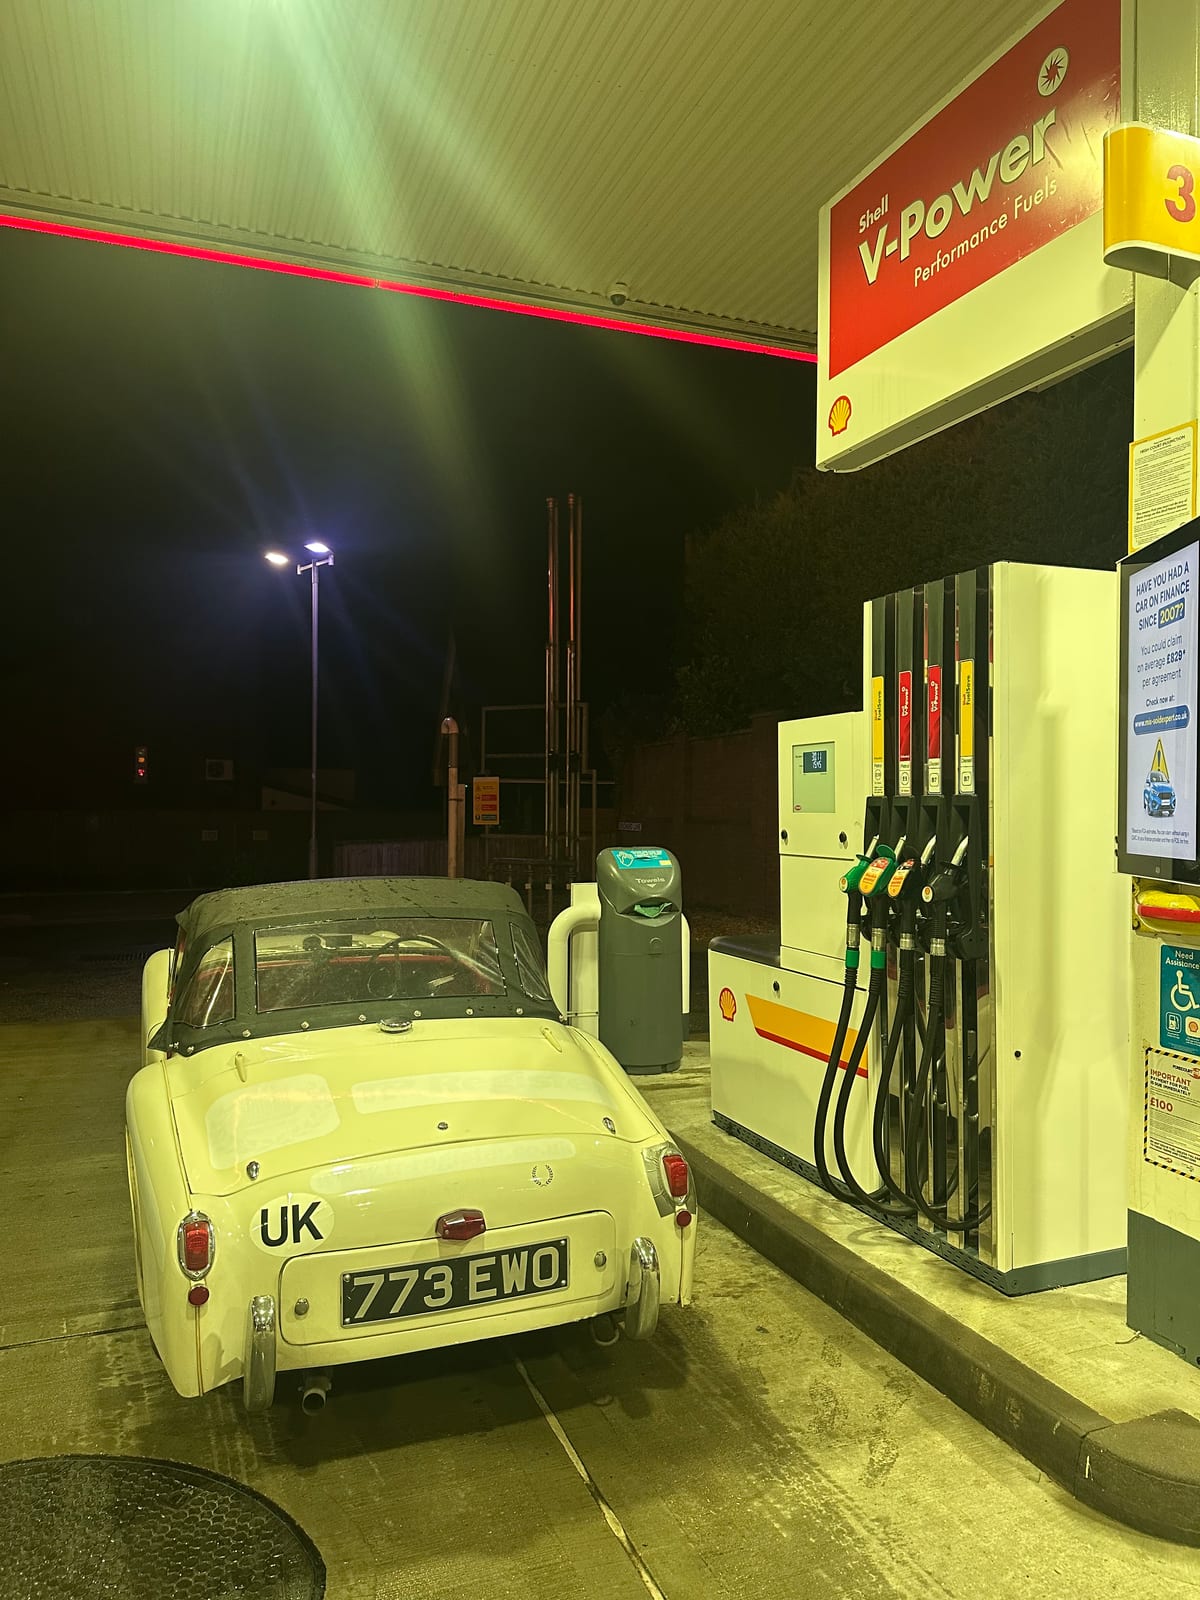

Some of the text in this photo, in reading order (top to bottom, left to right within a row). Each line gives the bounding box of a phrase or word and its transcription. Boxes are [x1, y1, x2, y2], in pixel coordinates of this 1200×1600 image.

[858, 108, 1056, 286] V-Power
[1164, 164, 1196, 223] 3
[859, 193, 889, 234] Shell
[914, 175, 1057, 288] Performance Fuels
[1136, 561, 1190, 597] HAVE YOU HAD A
[1136, 579, 1190, 613] CAR ON FINANCE
[1139, 602, 1184, 630] SINCE 2007?
[1141, 634, 1183, 656] You could claim
[1137, 664, 1144, 673] on
[1144, 657, 1166, 670] average
[1142, 668, 1182, 690] per agreement
[1175, 950, 1194, 960] Need
[1150, 1069, 1191, 1086] IMPORTANT
[1150, 1097, 1173, 1112] £100
[260, 1201, 324, 1247] UK
[353, 1246, 560, 1319] 773 EWO
